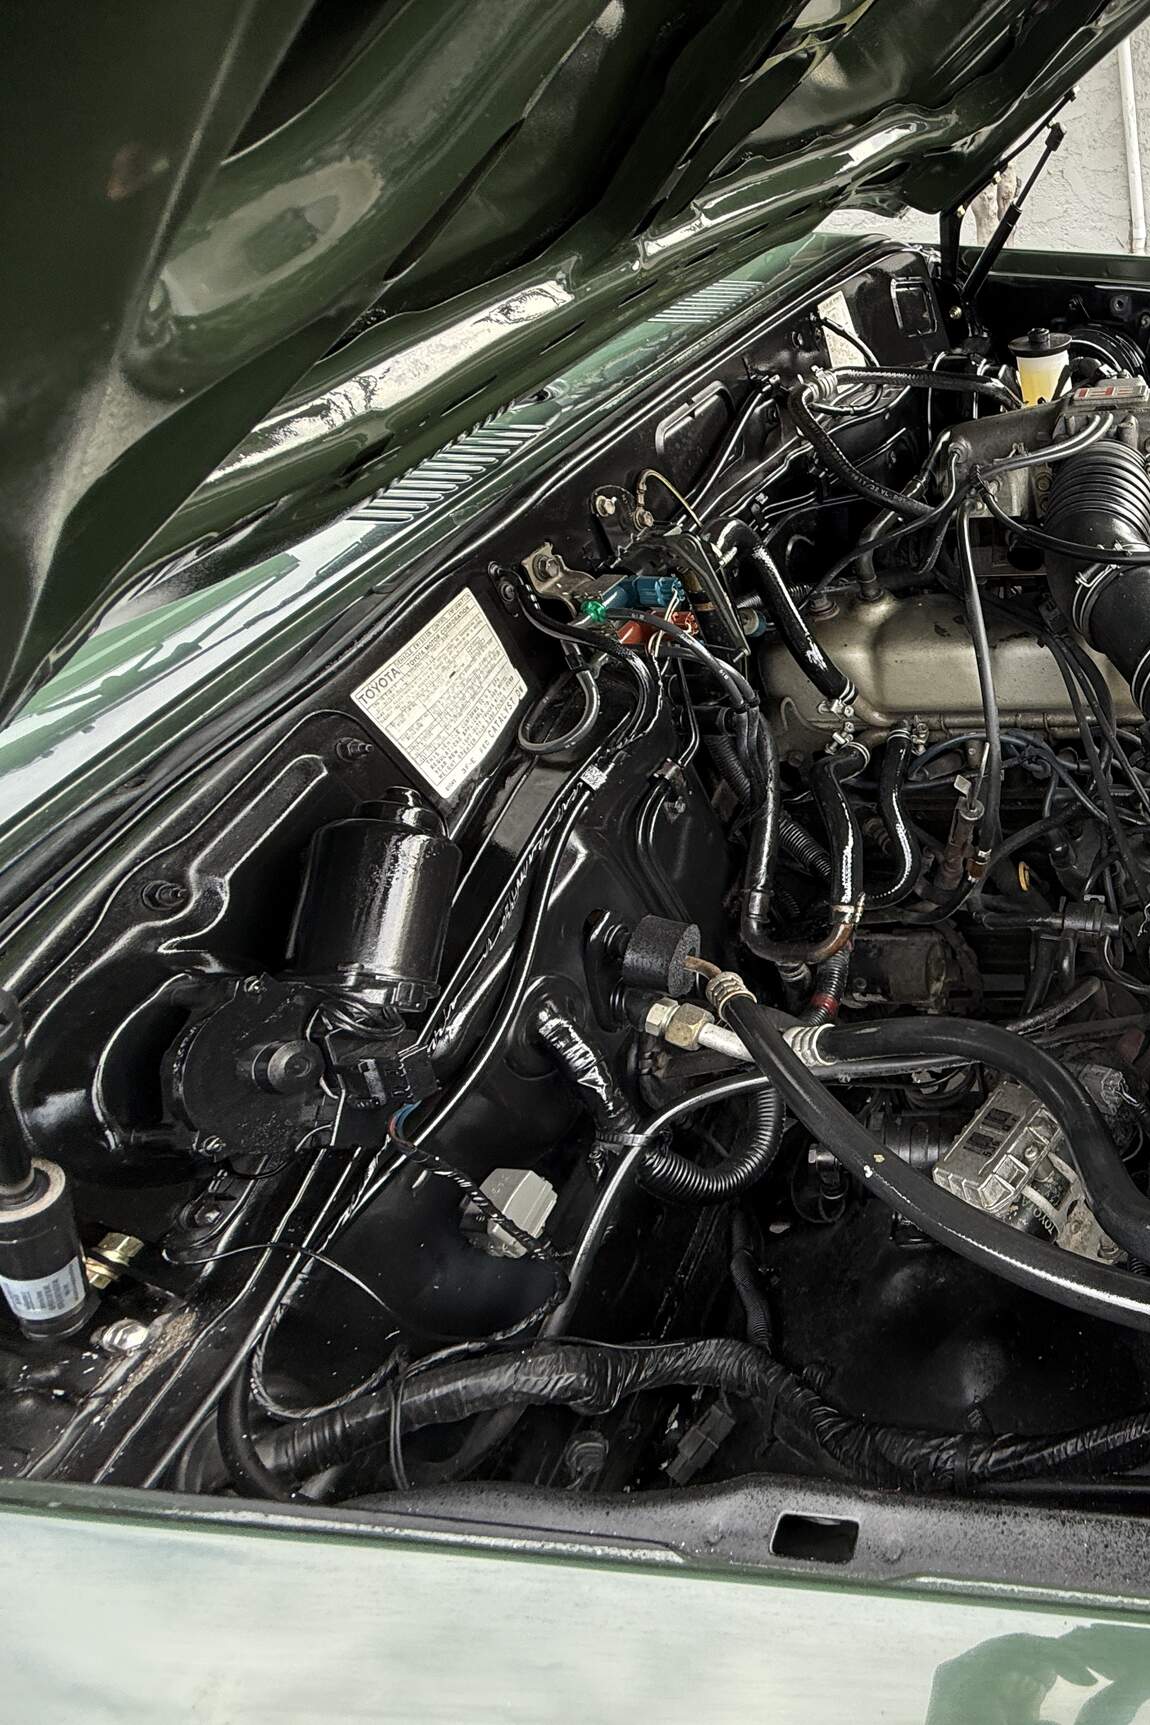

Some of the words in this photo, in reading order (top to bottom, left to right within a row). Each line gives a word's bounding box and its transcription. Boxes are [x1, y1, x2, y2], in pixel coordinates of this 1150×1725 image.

[405, 648, 425, 669] TOYOTA
[423, 633, 441, 651] MOTOR
[439, 604, 470, 636] CORPORATION
[358, 666, 401, 705] TOYOTA
[484, 696, 518, 740] CATALYST
